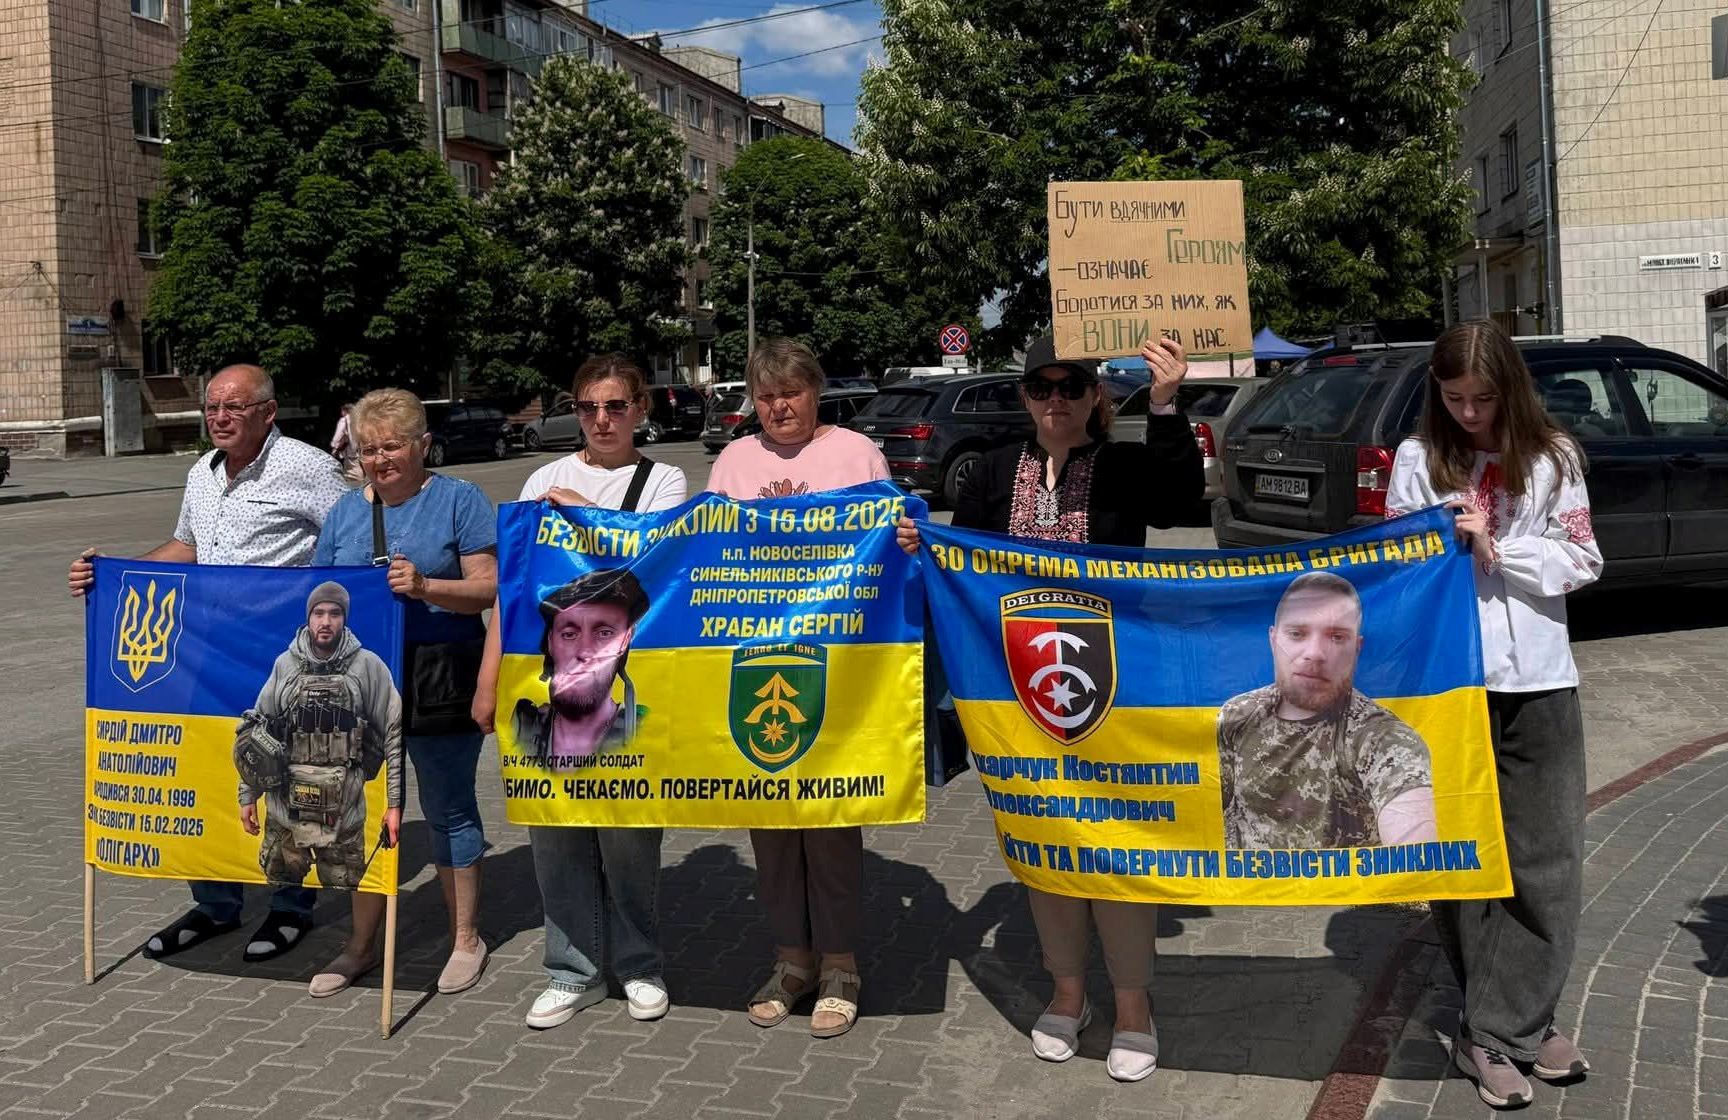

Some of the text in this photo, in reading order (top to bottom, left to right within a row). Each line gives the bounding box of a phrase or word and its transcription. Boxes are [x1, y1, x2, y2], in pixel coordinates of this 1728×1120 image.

[1055, 190, 1103, 238] Бути
[1712, 254, 1719, 265] 3
[1055, 288, 1139, 320] Боротися
[1083, 318, 1149, 353] ВОНИ
[1273, 478, 1293, 494] 9812
[1294, 480, 1307, 497] BA
[536, 516, 640, 557] БЕЗВІСТИ
[769, 496, 906, 534] 15.08.2025
[750, 543, 856, 561] НОВОСЕЛІВКА
[930, 530, 1446, 579] 30 ОКРЕМА МЕХАНІЗОВАНА БРИГАДА
[690, 563, 853, 582] СИНЕЛЬНИКІВСЬКОГО
[689, 581, 879, 606] ДНІПРОПЕТРОВСЬКОЇ ОБЛ
[1005, 592, 1107, 612] DEI GRATIA
[700, 608, 865, 638] ХРАБАН СЕРГІЙ
[97, 719, 183, 746] СИРДІЙ ДМИТРО
[98, 750, 177, 777] АНАТОЛІЙОВИЧ
[600, 754, 645, 769] СОЛДАТ
[972, 751, 1200, 785] харчук Костянтин
[131, 785, 196, 808] 30.04.1998
[502, 774, 885, 800] БИМО. ЧЕКАЄМО. ПОВЕРТАЙСЯ ЖИВИМ!
[99, 808, 136, 832] БЕЗВІСТИ
[139, 814, 204, 837] 15.02.2025
[1000, 833, 1482, 878] ЙТИ ТА ПОВЕРНУТИ БЕЗВІСТИ ЗНИКЛИХ
